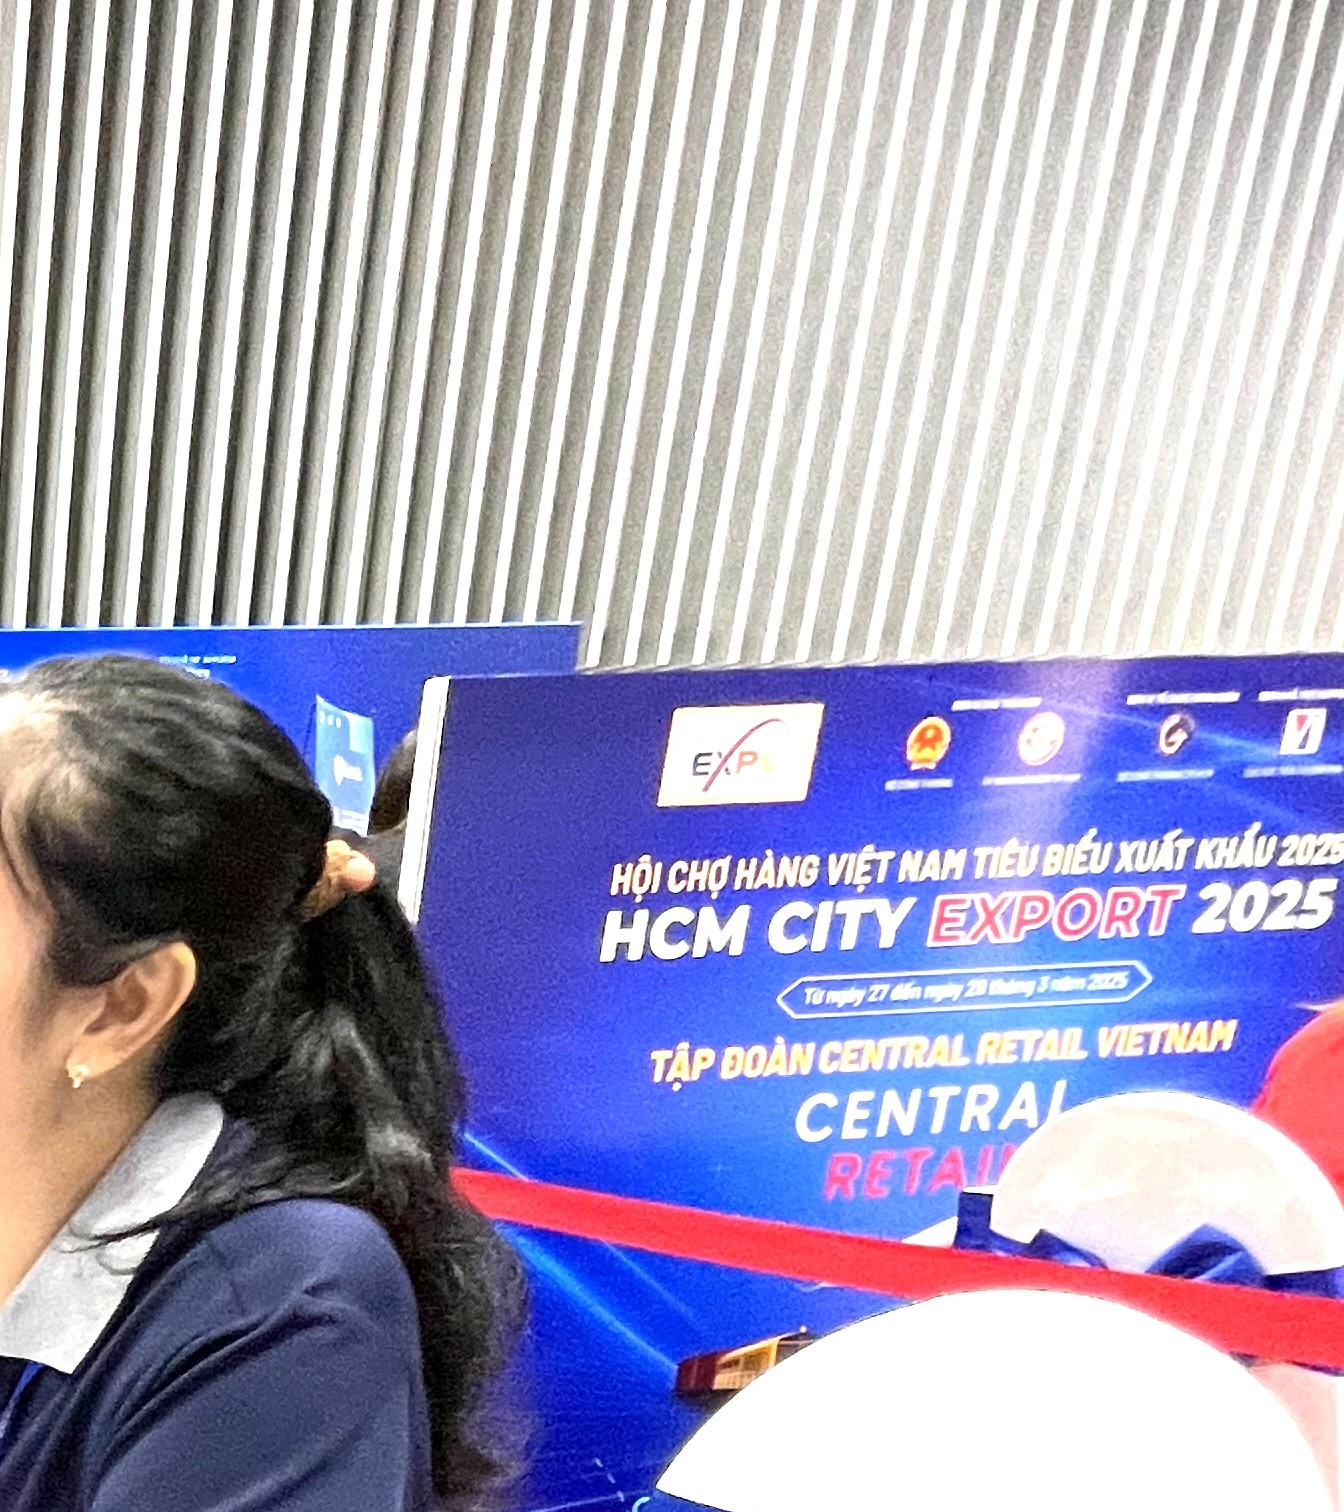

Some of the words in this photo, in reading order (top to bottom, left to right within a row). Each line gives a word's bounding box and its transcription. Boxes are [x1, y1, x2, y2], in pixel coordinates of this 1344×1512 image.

[611, 854, 661, 903] HỘI
[668, 854, 731, 899] CHỢ
[734, 848, 819, 890] HÀNG
[827, 843, 895, 893] VIỆT
[898, 848, 967, 883] NAM
[973, 837, 1039, 878] TIÊU
[1042, 827, 1111, 877] BIỂU
[1114, 828, 1194, 873] XUẤT
[1195, 821, 1278, 869] KHẨU
[1277, 832, 1344, 866] 2025
[599, 904, 751, 963] HCM
[767, 896, 917, 955] CITY
[926, 884, 1186, 947] EXPORT
[1191, 878, 1339, 935] 2025
[867, 983, 889, 1003] 27
[1038, 976, 1049, 993] 3
[1088, 972, 1130, 990] 2025
[650, 1041, 714, 1091] TẬP
[721, 1035, 815, 1080] ĐOÀN
[819, 1033, 970, 1075] CENTRAL
[977, 1027, 1087, 1066] RETAIL
[1098, 1019, 1238, 1058] VIETNAM
